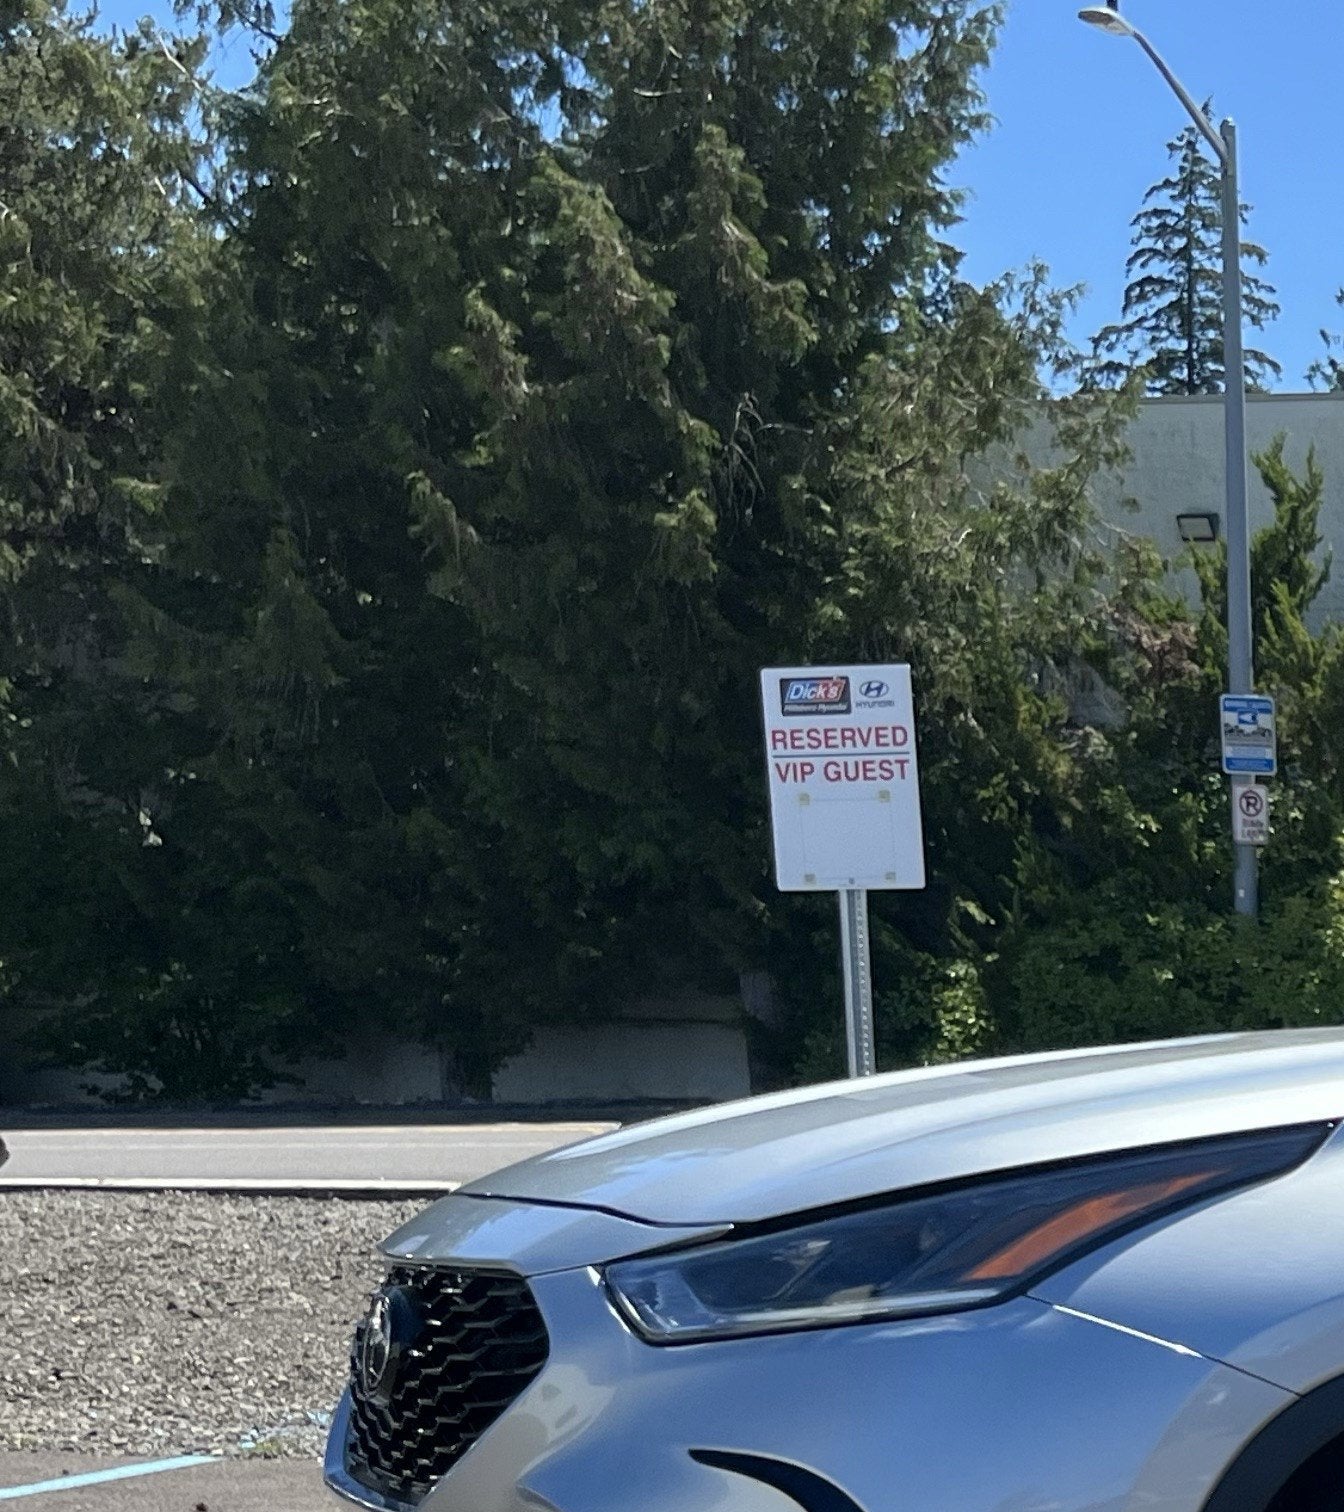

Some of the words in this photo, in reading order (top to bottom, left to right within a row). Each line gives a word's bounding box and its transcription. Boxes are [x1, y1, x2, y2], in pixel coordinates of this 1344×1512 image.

[771, 726, 909, 750] RESERVED
[774, 761, 815, 784] VIP
[823, 759, 910, 782] GUEST
